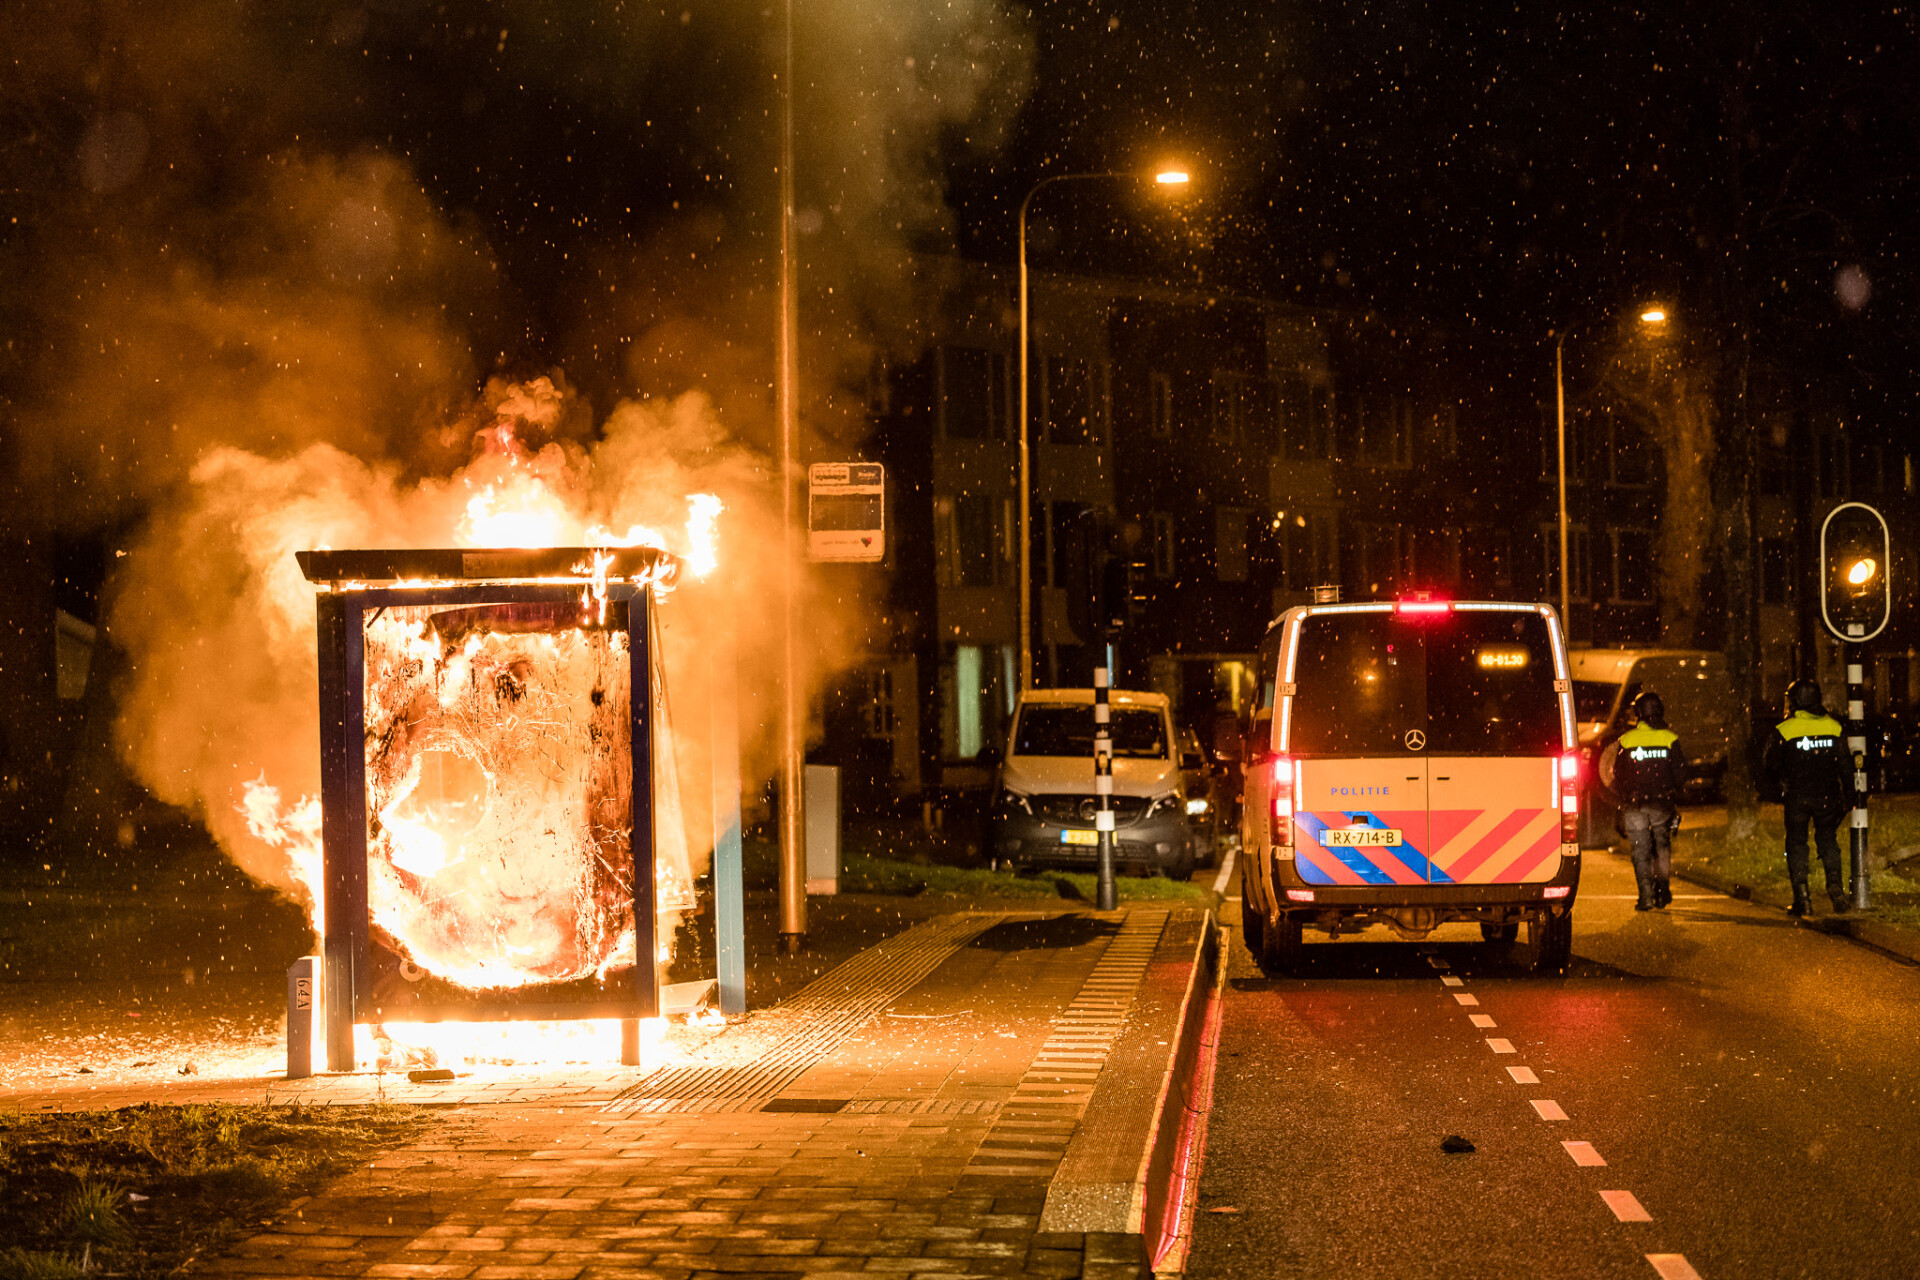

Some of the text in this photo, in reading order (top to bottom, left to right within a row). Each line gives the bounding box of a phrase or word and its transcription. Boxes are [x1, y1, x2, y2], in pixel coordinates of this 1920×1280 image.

[1331, 786, 1390, 796] POLITIE
[1333, 831, 1394, 844] RX-714-B
[298, 980, 310, 1008] 64A
